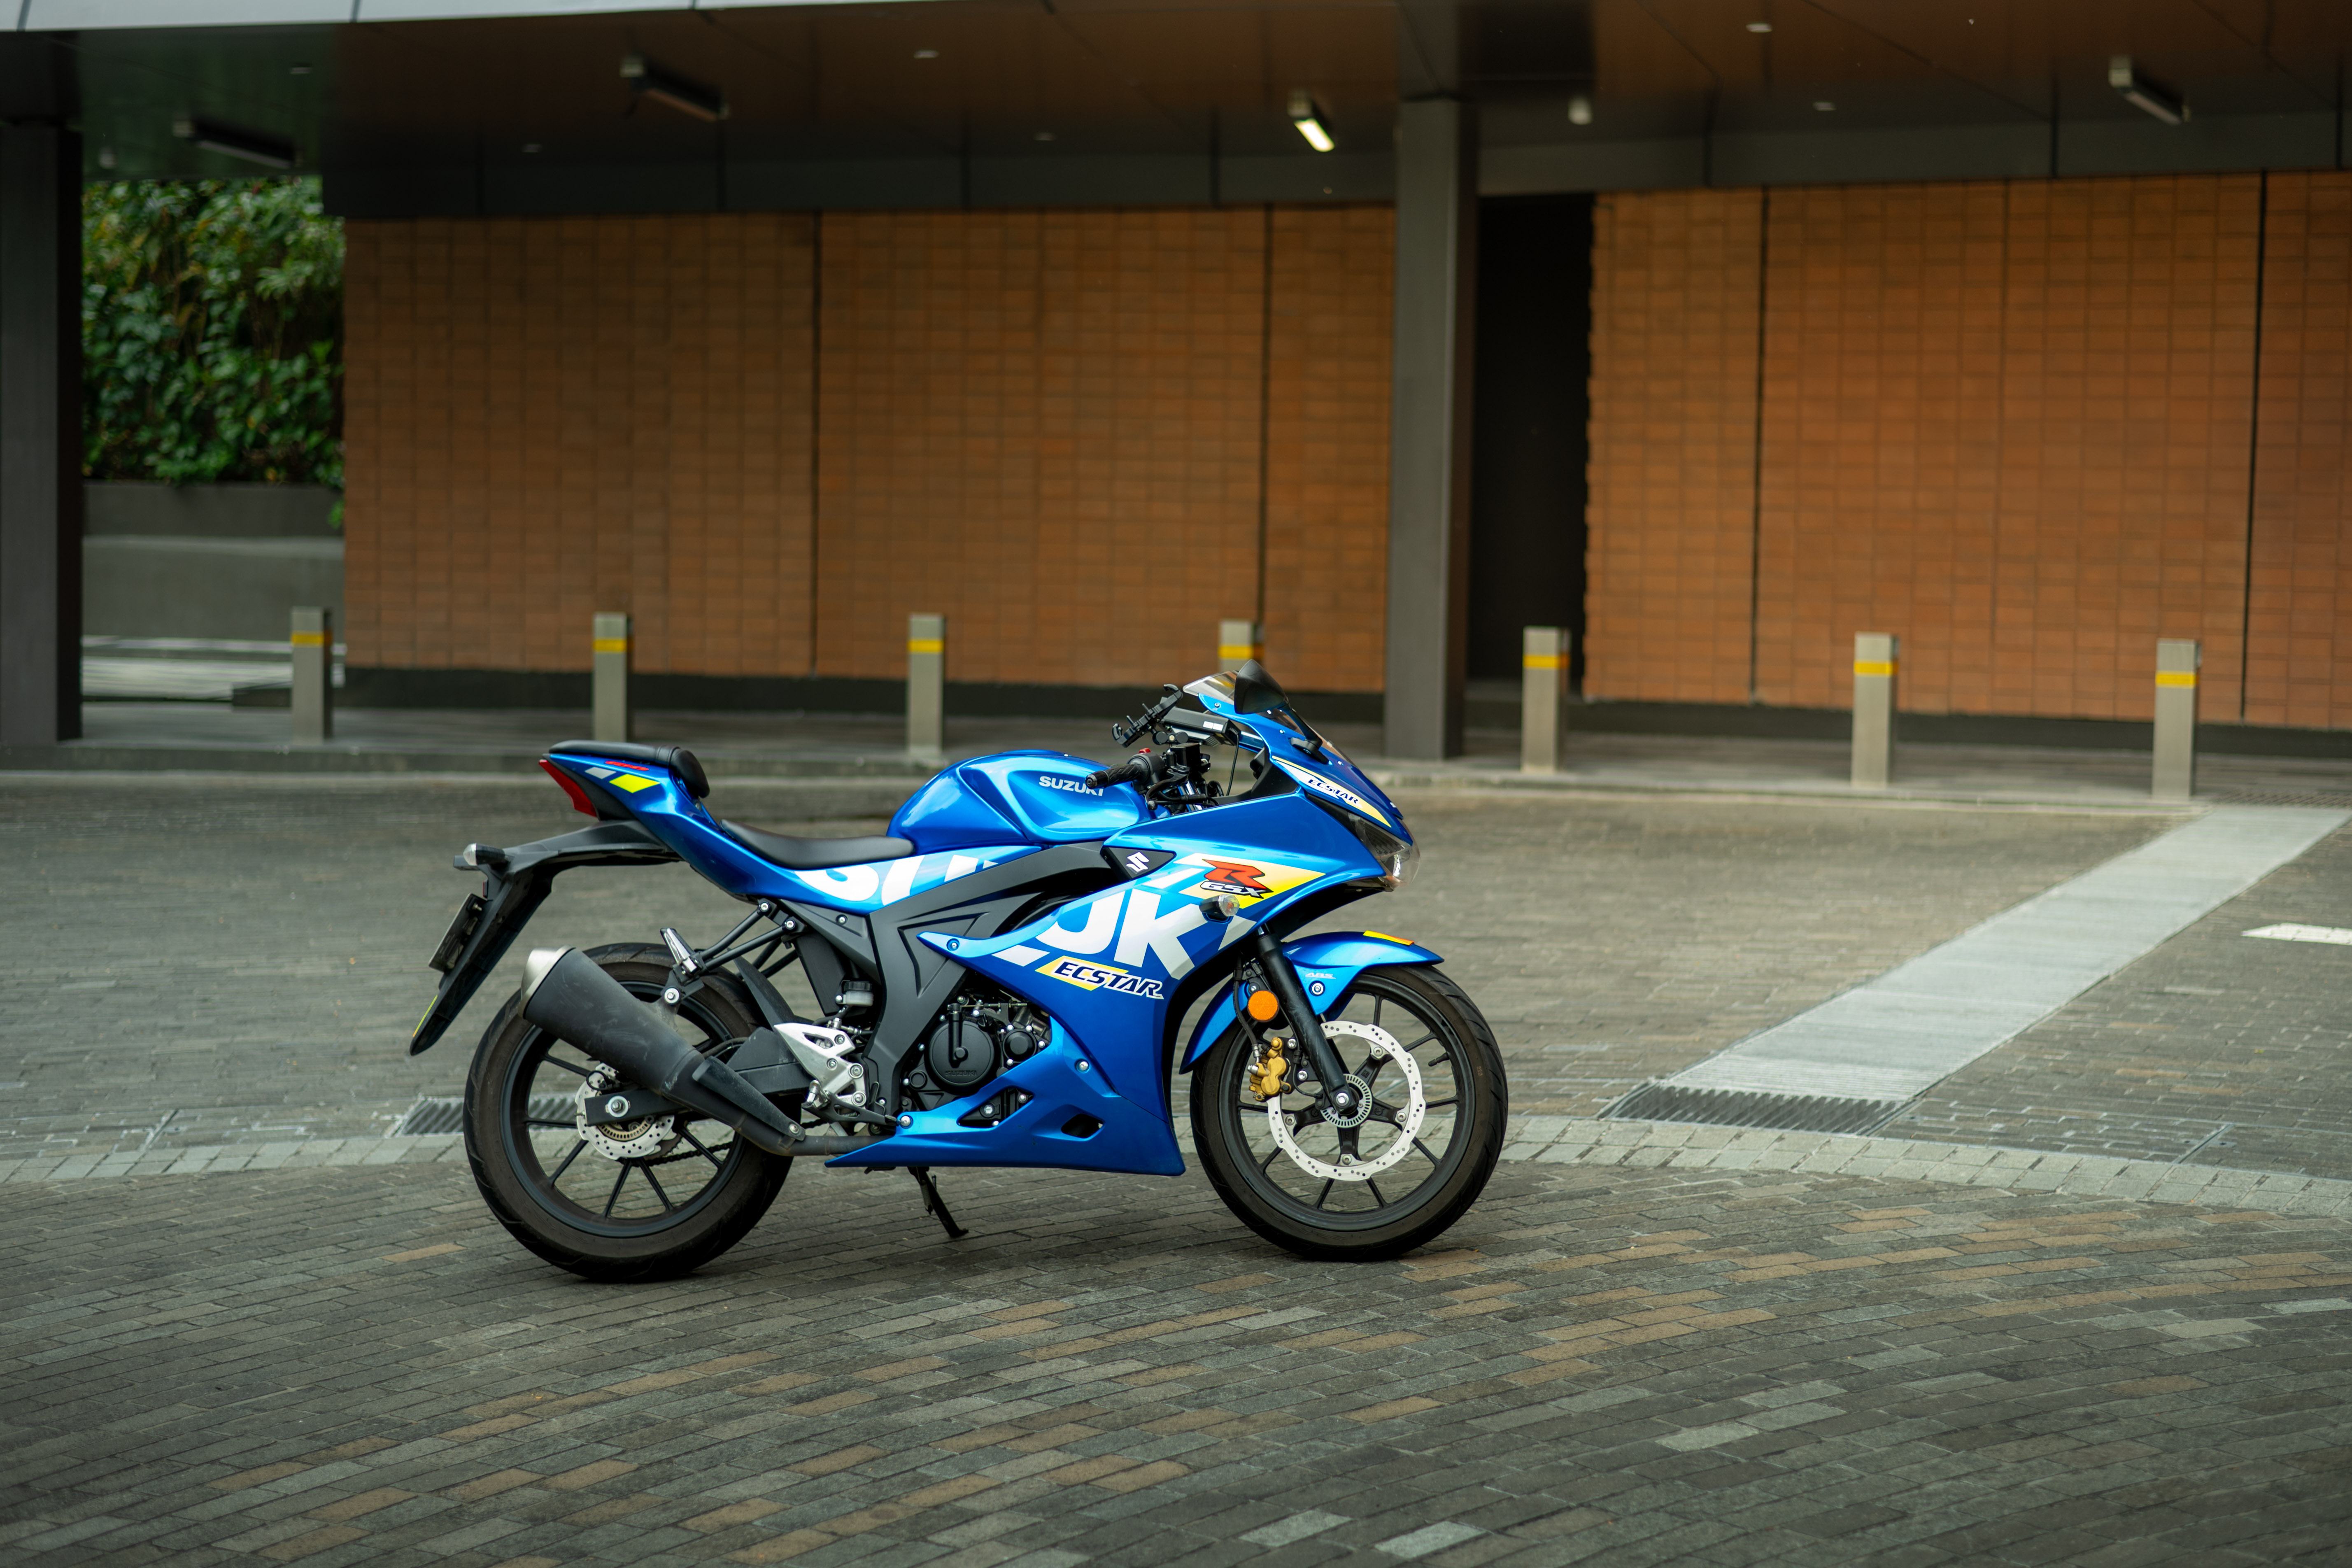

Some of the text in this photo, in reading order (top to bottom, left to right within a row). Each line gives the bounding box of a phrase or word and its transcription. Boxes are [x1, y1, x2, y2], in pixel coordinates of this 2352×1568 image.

[1308, 779, 1359, 804] ECSTAR
[1200, 881, 1267, 898] GSX
[1054, 961, 1162, 998] ECSTAR
